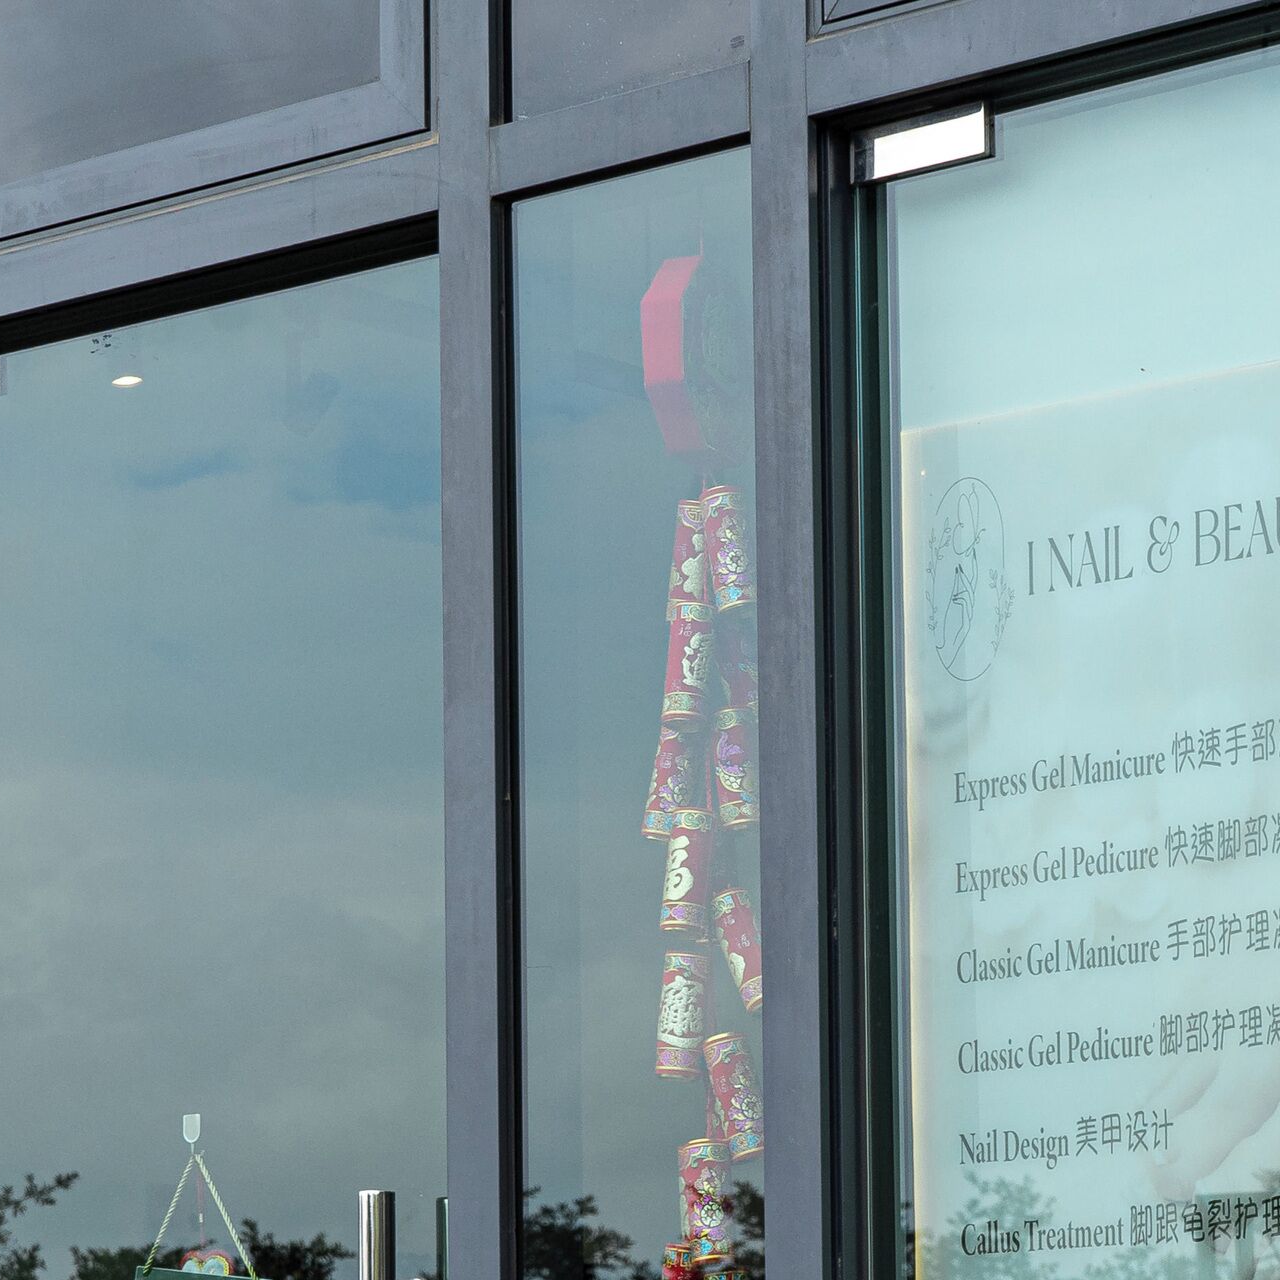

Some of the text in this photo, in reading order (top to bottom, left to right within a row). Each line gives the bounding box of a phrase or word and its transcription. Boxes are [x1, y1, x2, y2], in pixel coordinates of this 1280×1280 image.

[1027, 541, 1035, 595] I
[1048, 525, 1134, 592] NAIL
[1147, 515, 1180, 573] &
[954, 767, 1027, 810] Express
[1032, 754, 1066, 793] Gel
[1070, 749, 1166, 787] Manicure
[955, 858, 1028, 901] Express
[1032, 845, 1067, 884] Gel
[1071, 839, 1159, 878] Pedicure
[956, 947, 1022, 984] Classic
[1026, 937, 1061, 976] Gel
[1065, 934, 1160, 972] Manicure
[958, 1038, 1024, 1074] Classic
[1028, 1029, 1062, 1068] Gel
[1067, 1027, 1153, 1065] Pedicure
[959, 1108, 1174, 1170] Nail Design 美甲设计
[961, 1219, 1020, 1256] Callus
[1024, 1217, 1124, 1253] Treatment
